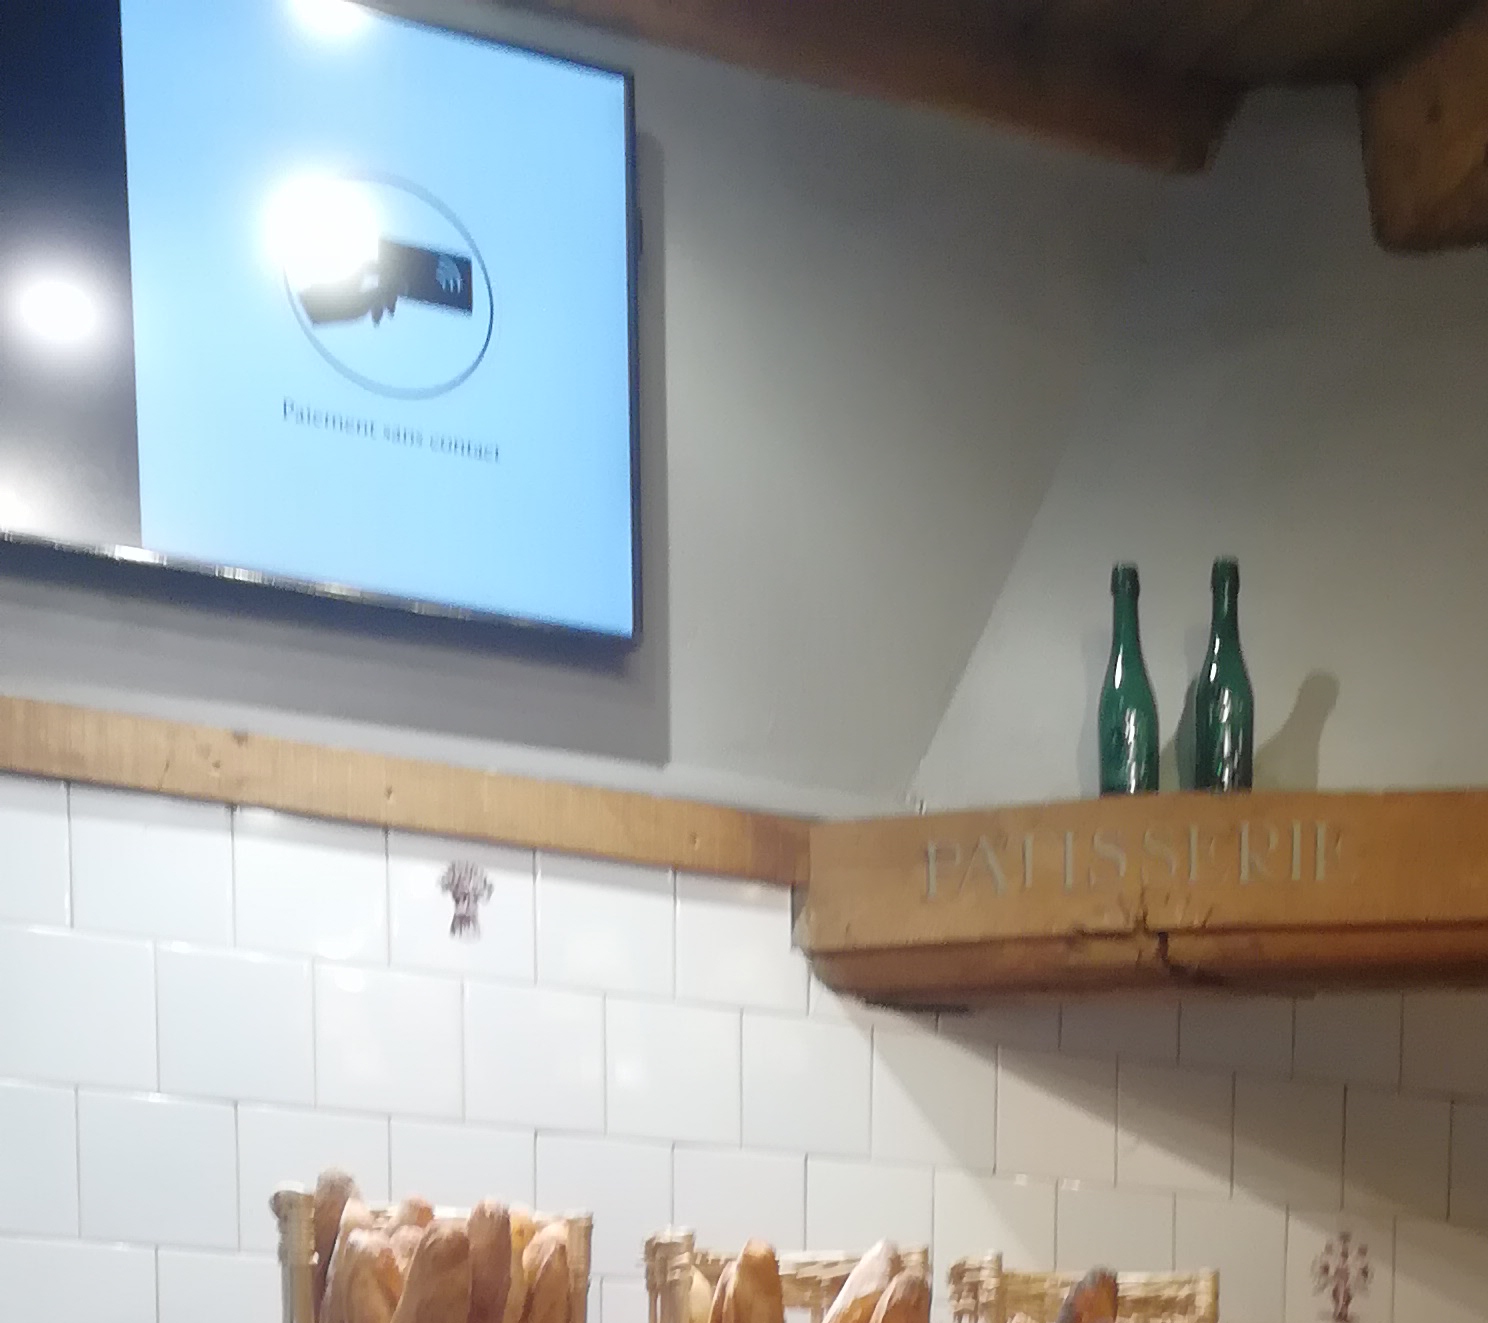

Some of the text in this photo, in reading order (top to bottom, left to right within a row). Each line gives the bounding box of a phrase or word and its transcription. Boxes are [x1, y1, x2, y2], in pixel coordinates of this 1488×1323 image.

[282, 397, 500, 463] Paiement sans contact
